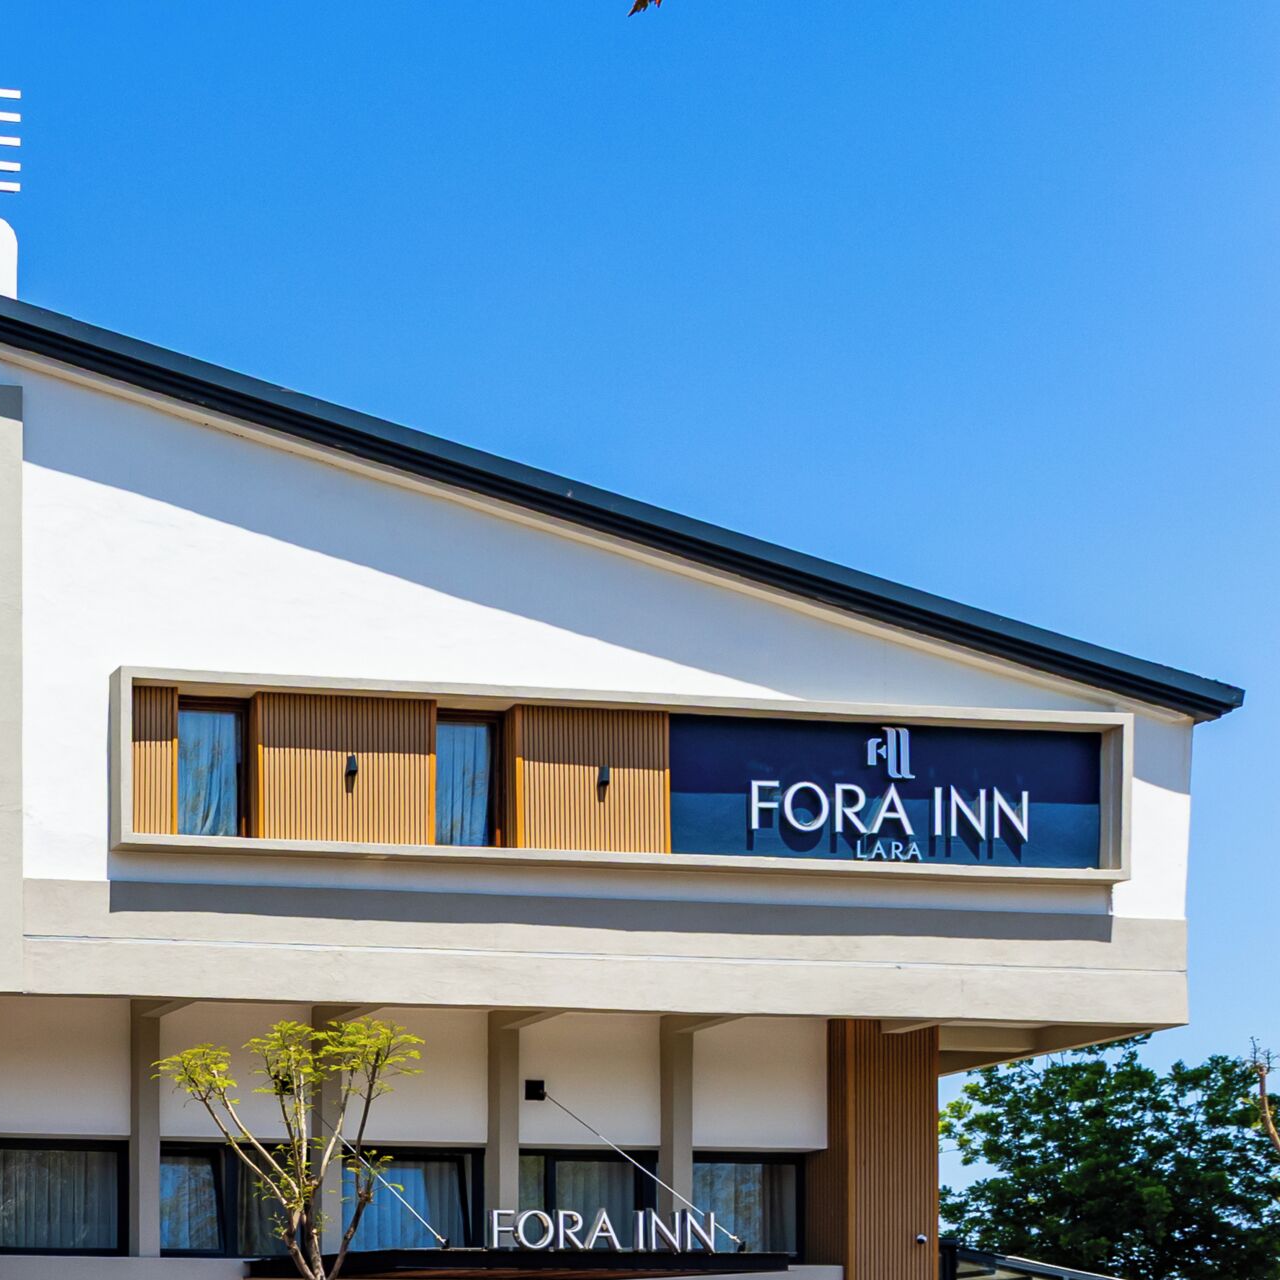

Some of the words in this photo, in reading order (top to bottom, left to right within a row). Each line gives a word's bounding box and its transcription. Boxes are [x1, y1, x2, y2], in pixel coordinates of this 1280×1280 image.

[750, 780, 915, 837] FORA
[933, 785, 1029, 843] INN
[856, 840, 923, 861] LARA
[490, 1208, 622, 1250] FORA
[633, 1208, 715, 1254] INN
